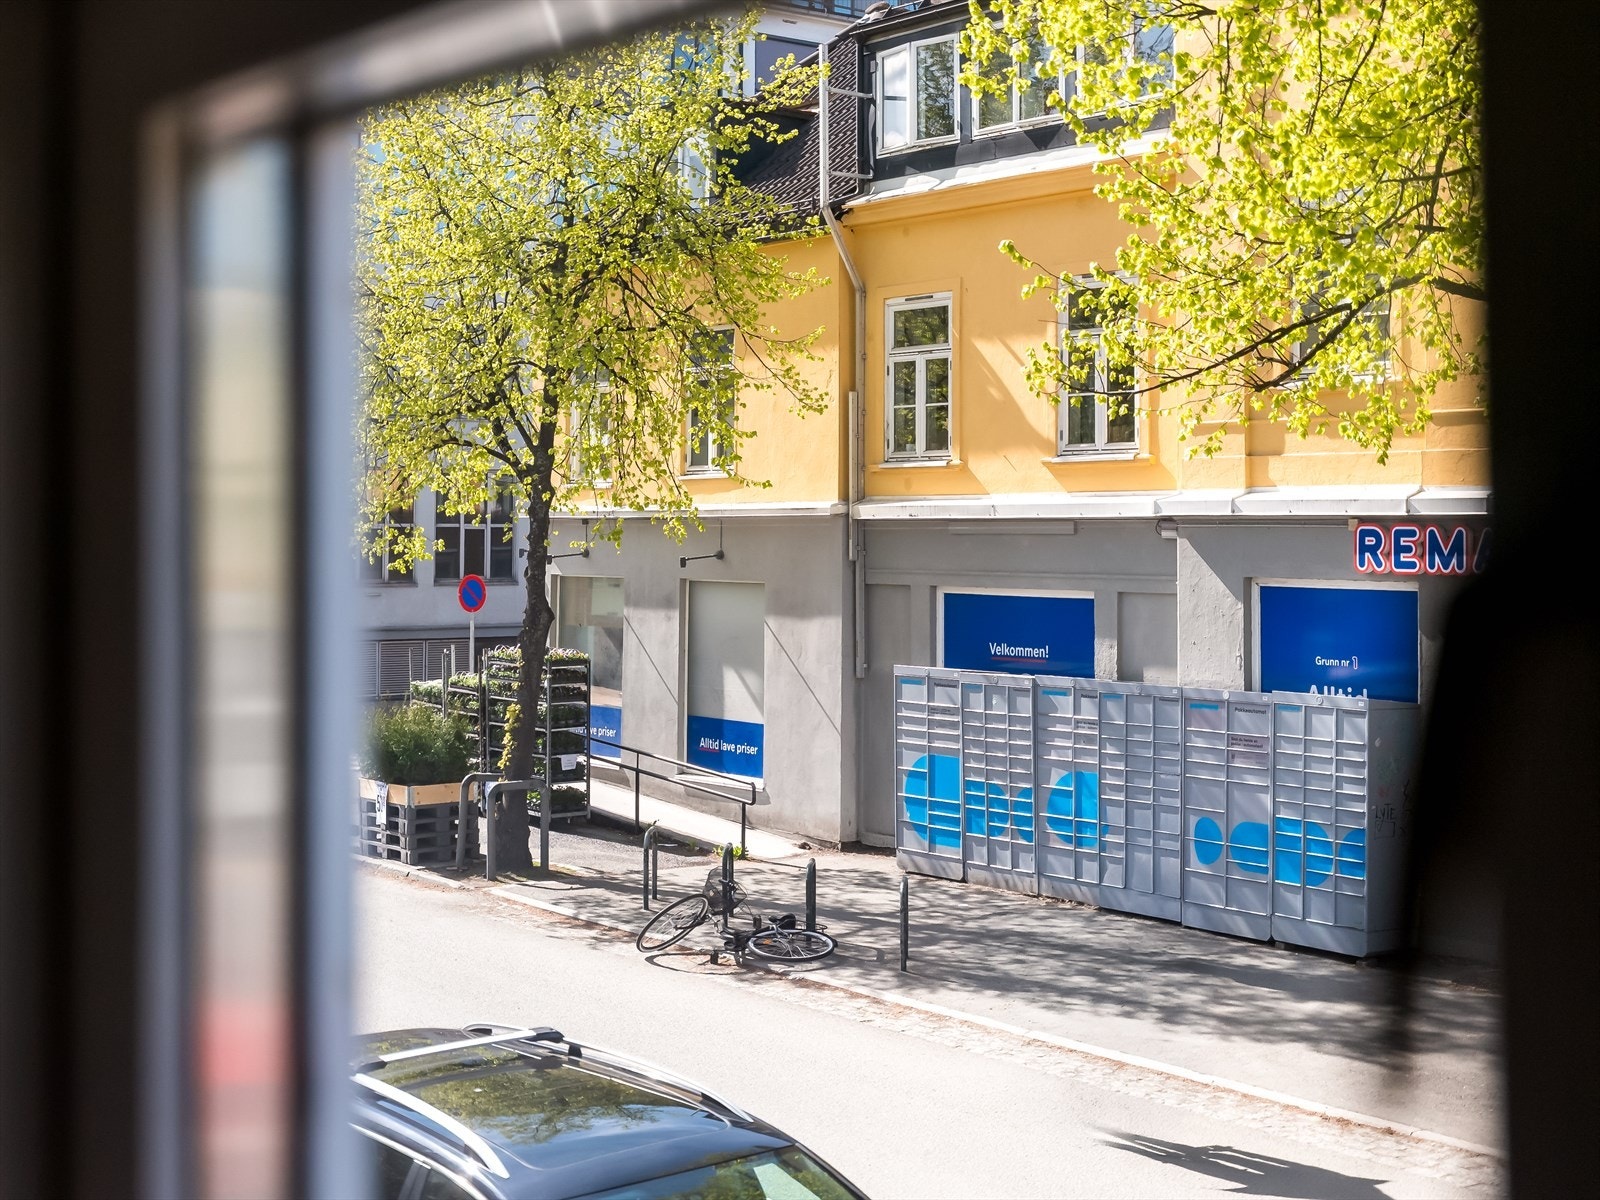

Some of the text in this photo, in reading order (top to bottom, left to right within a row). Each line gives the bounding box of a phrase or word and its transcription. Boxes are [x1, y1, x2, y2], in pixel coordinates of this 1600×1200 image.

[989, 642, 1049, 658] Velkommen!
[1315, 655, 1358, 670] Grunn nr 1
[597, 725, 617, 738] priser
[699, 737, 759, 755] Alltid lave priser
